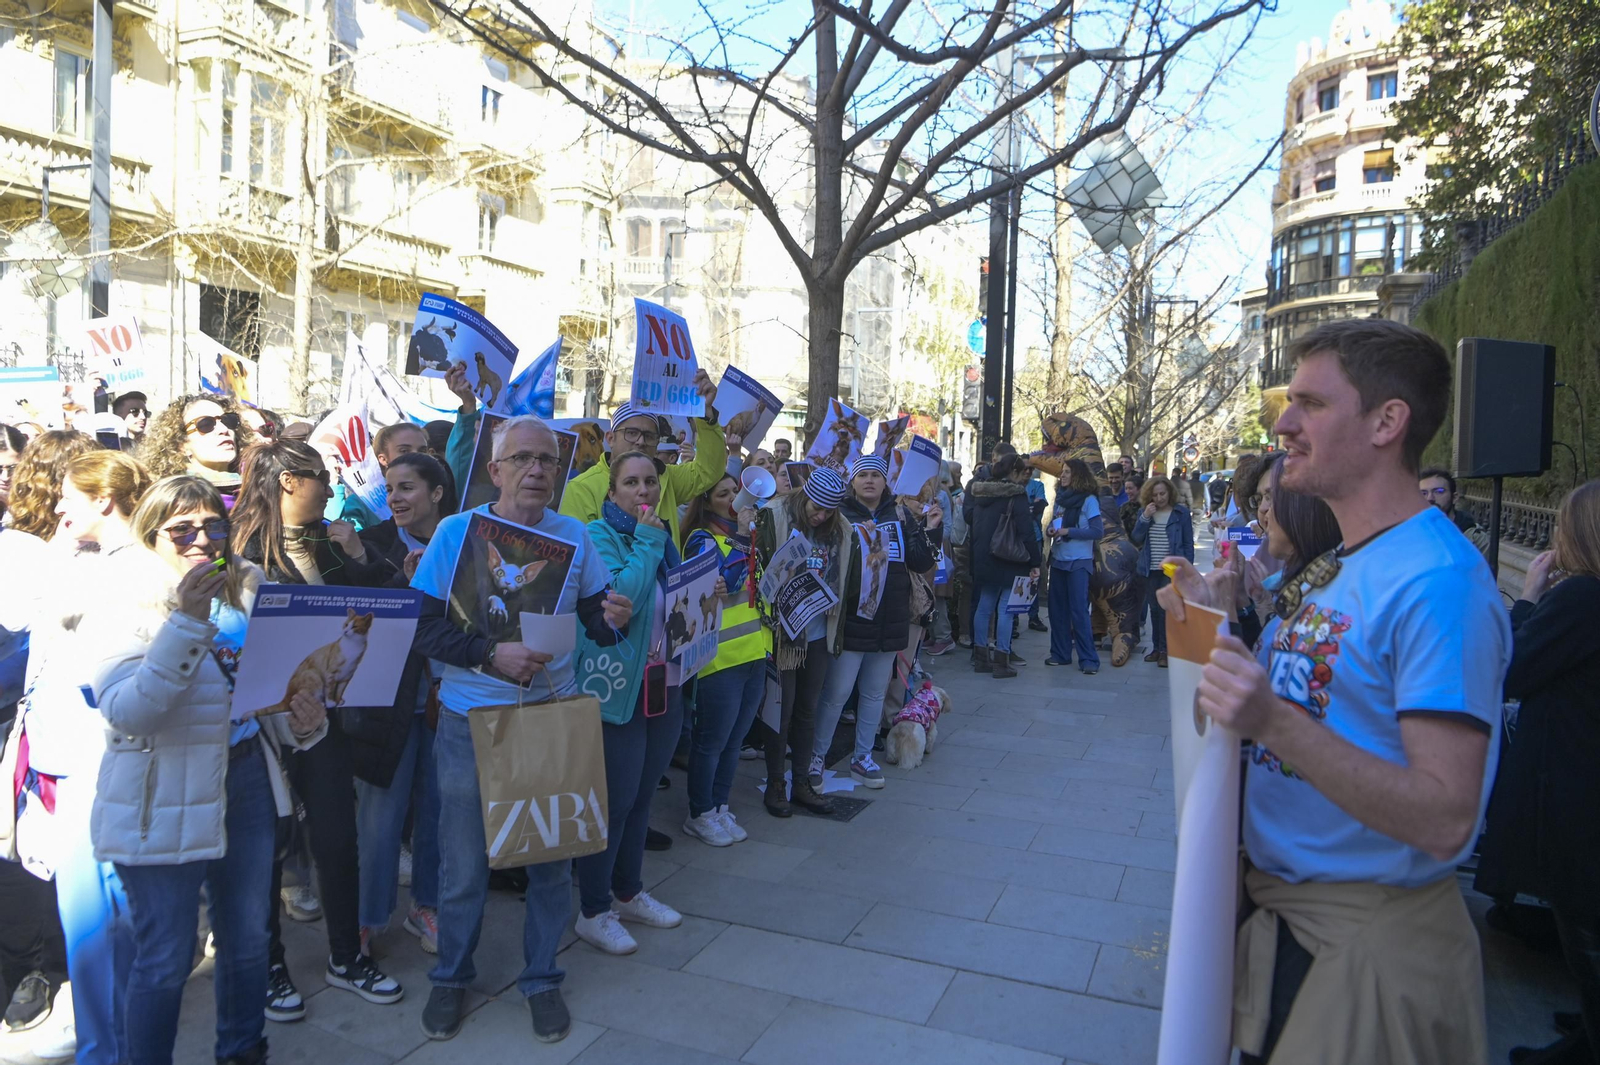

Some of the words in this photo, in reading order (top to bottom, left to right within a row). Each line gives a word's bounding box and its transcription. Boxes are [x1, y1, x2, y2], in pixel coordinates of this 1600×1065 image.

[86, 324, 132, 357] NO
[645, 314, 691, 361] NO
[662, 362, 679, 378] AL
[635, 380, 662, 402] RD
[666, 384, 701, 407] 666
[317, 415, 366, 468] NO
[353, 470, 367, 488] AL
[476, 520, 500, 541] RD
[684, 643, 698, 671] RD
[699, 630, 717, 657] 666
[488, 786, 608, 858] ZARA
